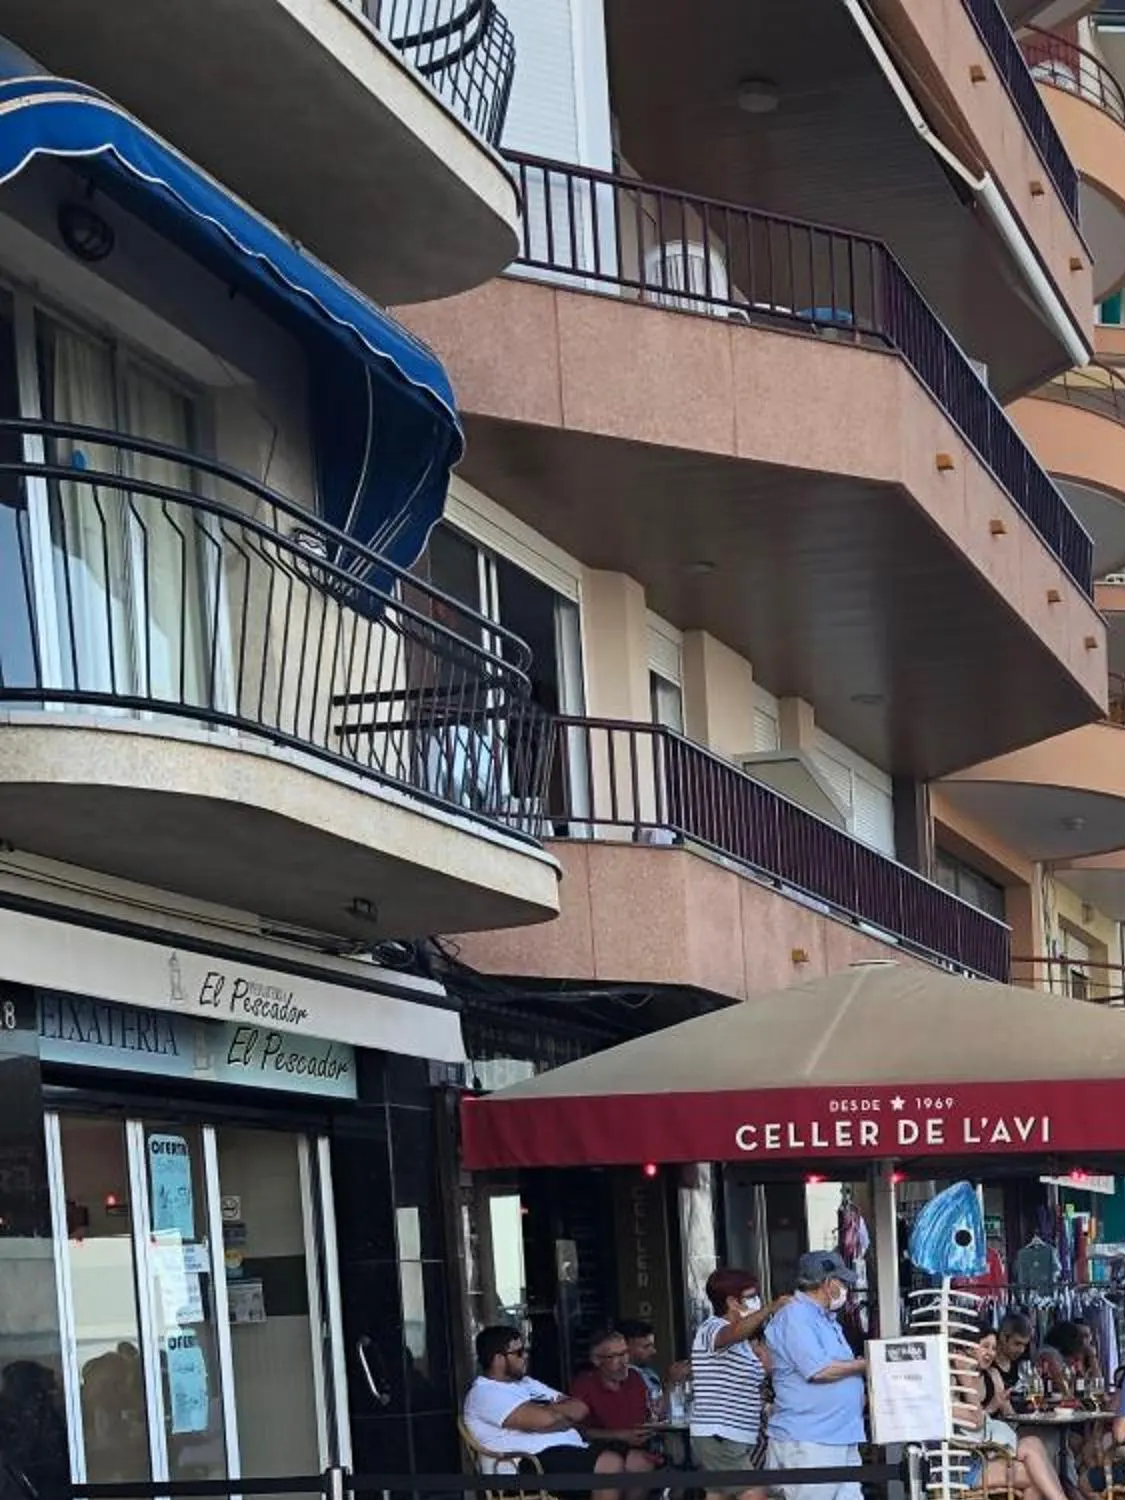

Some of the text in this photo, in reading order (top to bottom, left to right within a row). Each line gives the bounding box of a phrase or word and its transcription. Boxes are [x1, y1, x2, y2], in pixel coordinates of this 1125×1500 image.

[199, 972, 225, 1008] El
[230, 978, 308, 1024] Pescador
[227, 1027, 349, 1080] El Pescador
[829, 1097, 953, 1112] DESDE 1969
[735, 1116, 1050, 1151] CELLER DE L'AVI
